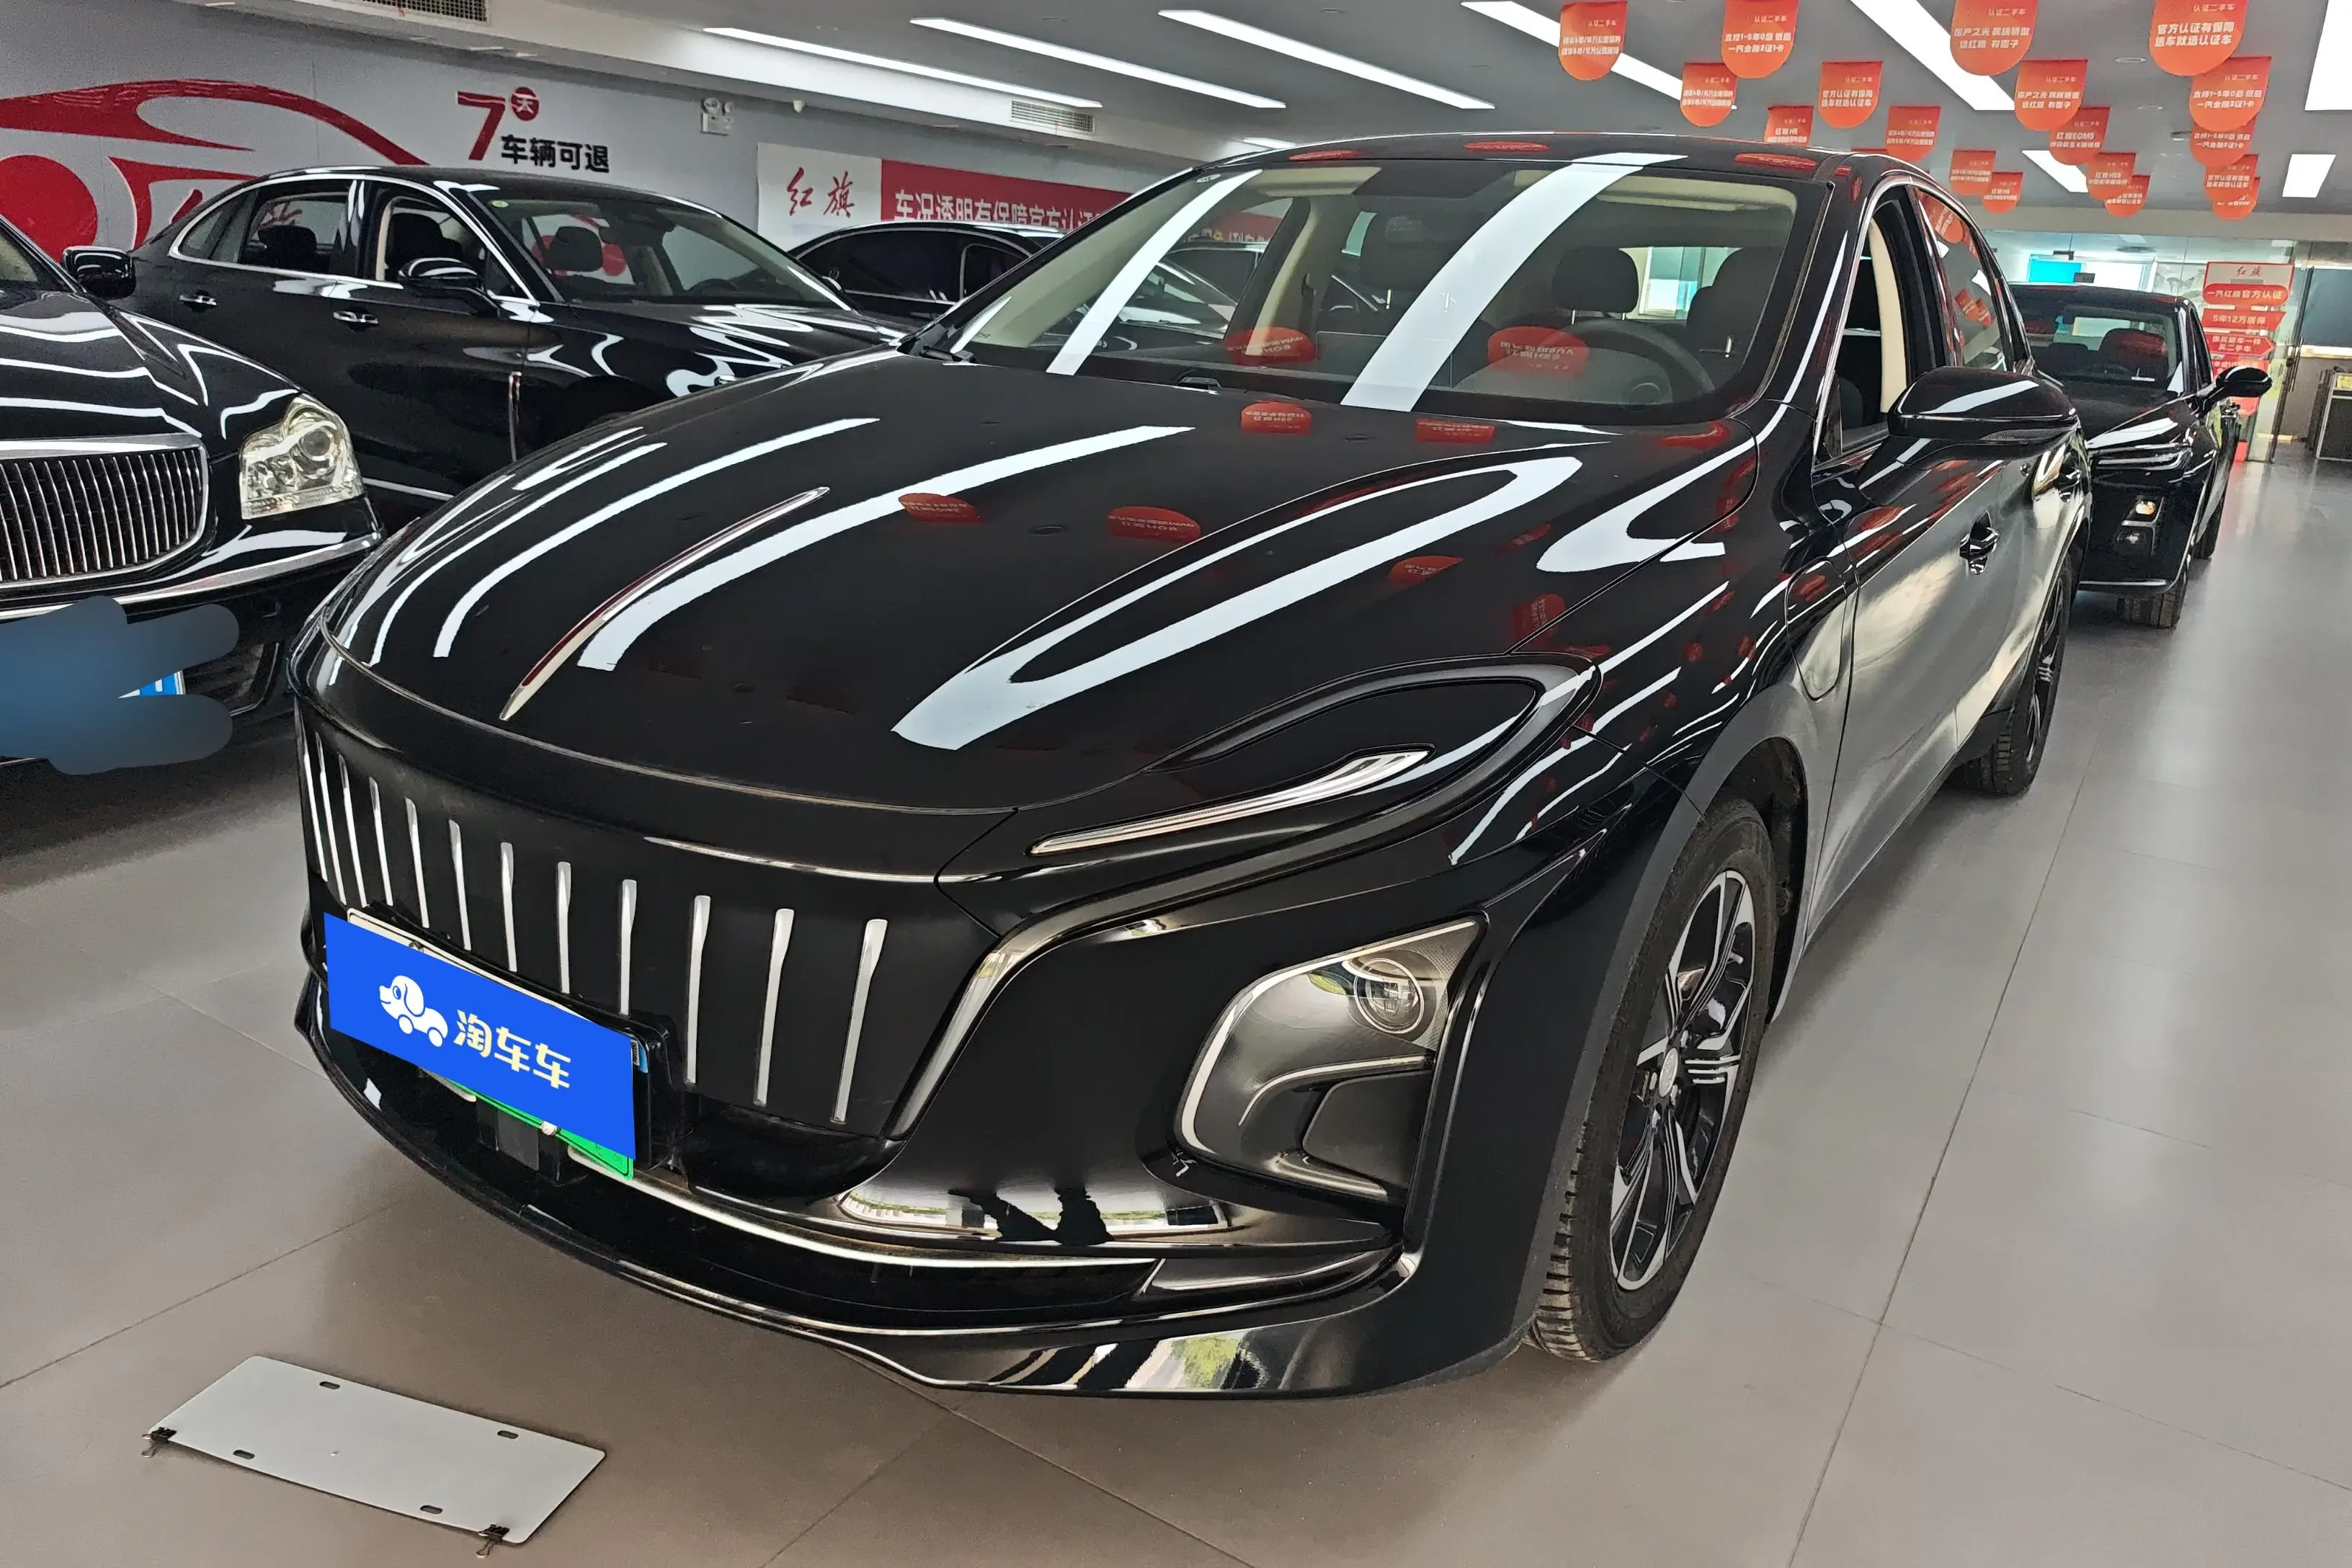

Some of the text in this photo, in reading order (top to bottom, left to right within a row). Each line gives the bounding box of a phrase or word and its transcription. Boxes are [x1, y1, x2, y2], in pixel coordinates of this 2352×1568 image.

[458, 91, 506, 161] 7
[501, 134, 610, 173] 车辆可退
[787, 166, 855, 218] 红旗
